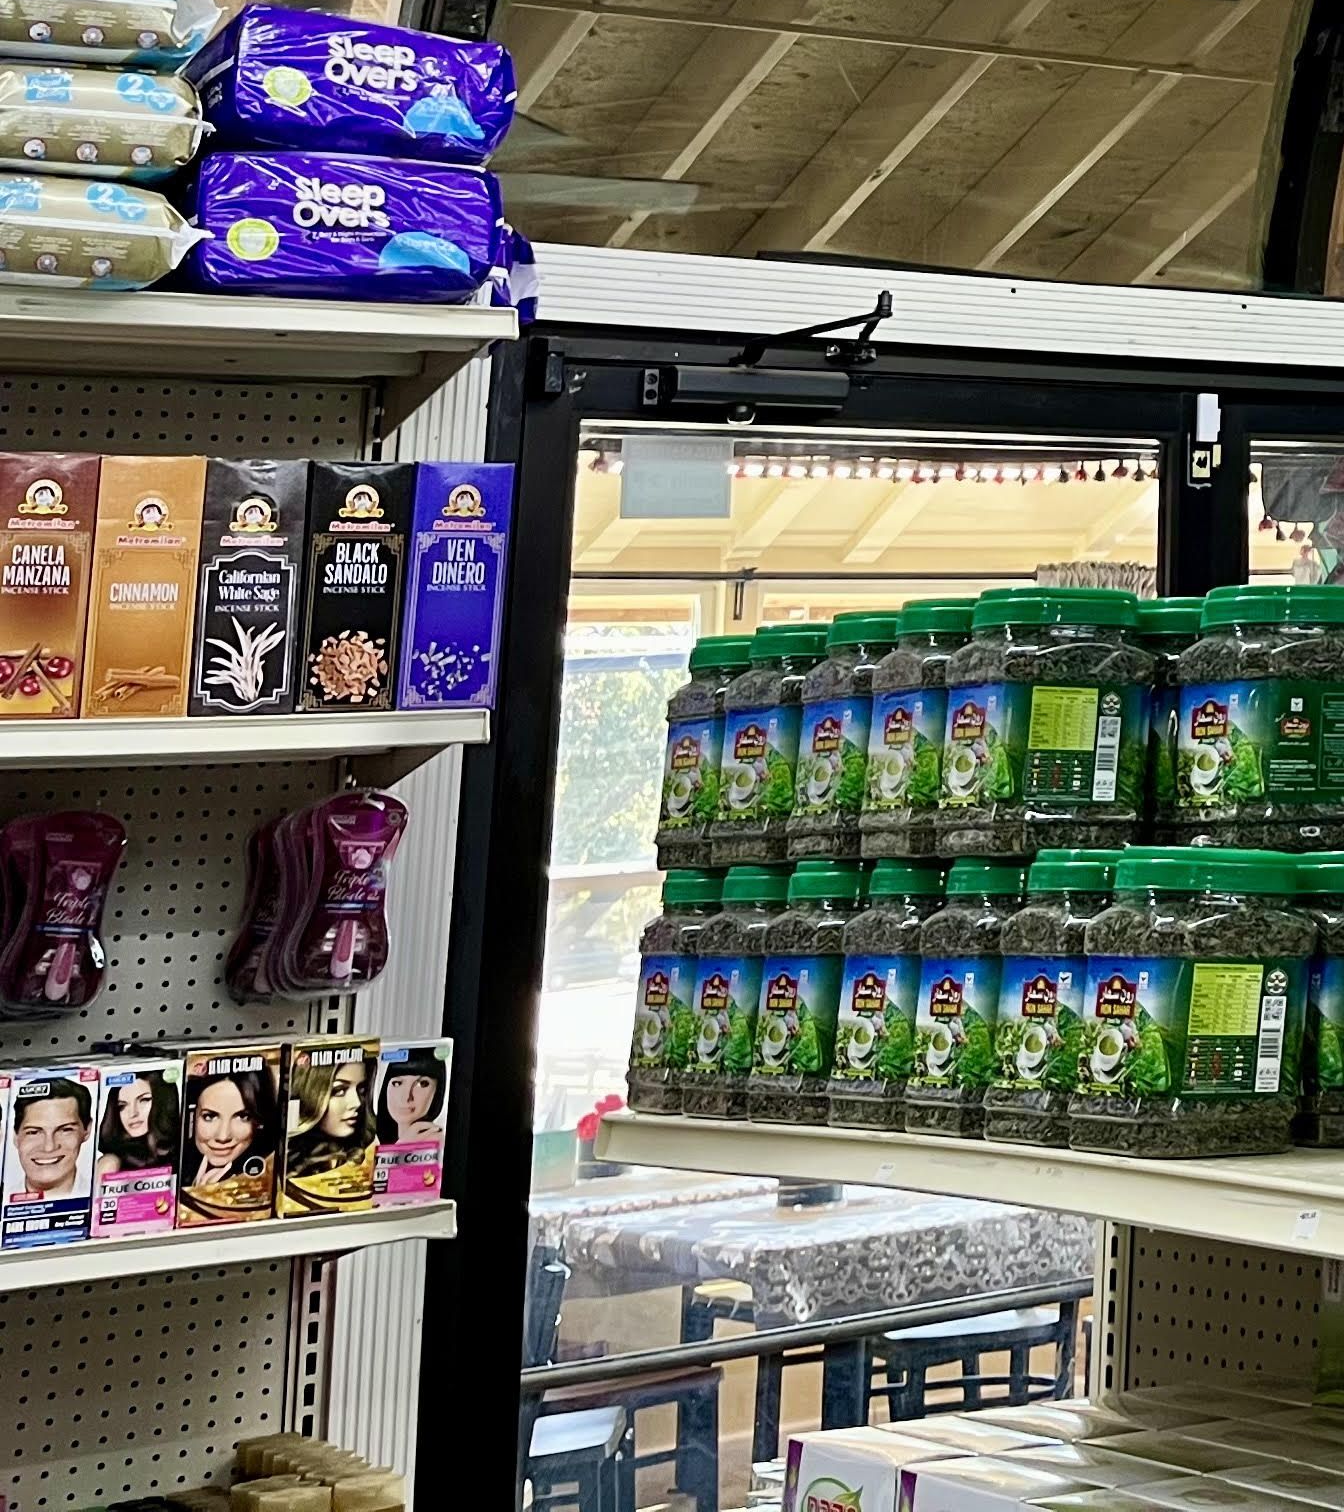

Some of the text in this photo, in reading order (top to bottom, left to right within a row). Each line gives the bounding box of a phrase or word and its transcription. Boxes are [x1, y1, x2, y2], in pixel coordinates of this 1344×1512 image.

[328, 35, 416, 65] Sleep
[324, 58, 419, 91] Overs
[295, 176, 386, 206] Sleep
[292, 200, 390, 228] Overs
[12, 545, 64, 564] CANELA
[336, 542, 380, 563] BLACK
[447, 539, 475, 561] VEN
[3, 566, 70, 586] MANZANA
[218, 569, 281, 585] Californian
[324, 564, 388, 585] SANDALO
[432, 562, 485, 585] DINERO
[110, 583, 178, 602] CINNAMON
[218, 586, 280, 603] White Sage
[208, 1056, 263, 1075] HAIR COLOR
[311, 1049, 363, 1067] HAIR COLOR
